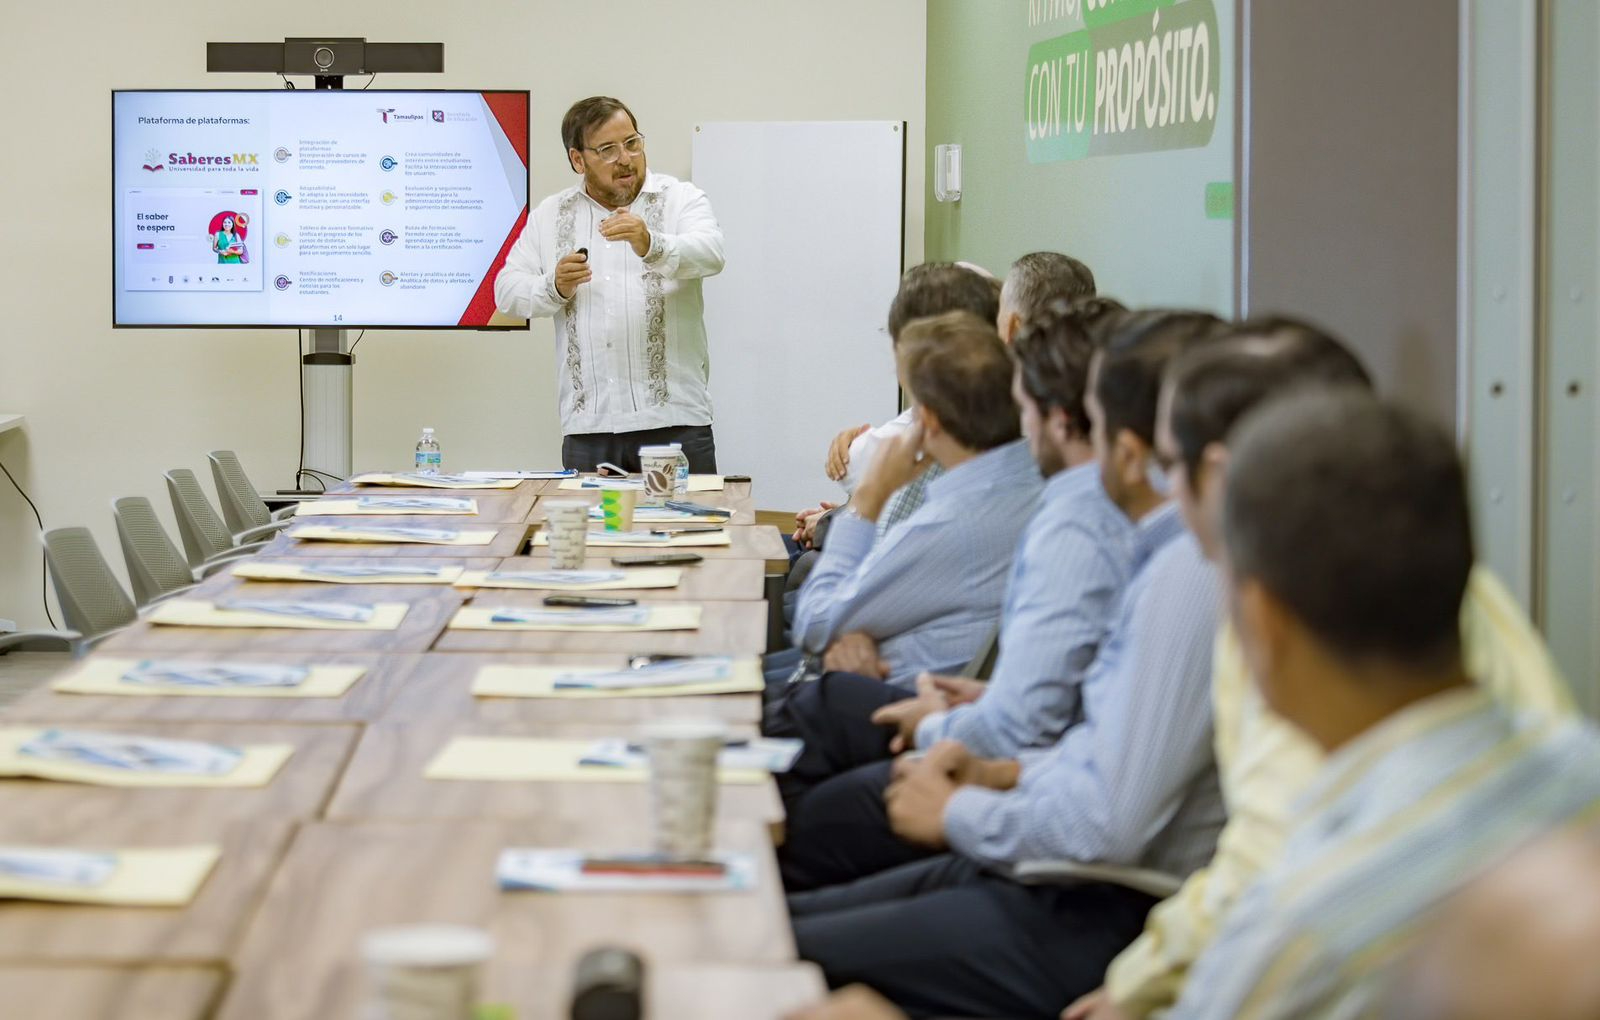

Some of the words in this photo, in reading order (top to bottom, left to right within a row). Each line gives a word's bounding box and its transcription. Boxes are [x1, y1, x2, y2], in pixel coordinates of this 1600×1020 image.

[1029, 58, 1062, 141] CON
[1066, 50, 1088, 133] TU
[1093, 7, 1214, 135] PROPÓSITO.
[198, 117, 250, 126] plataformas:
